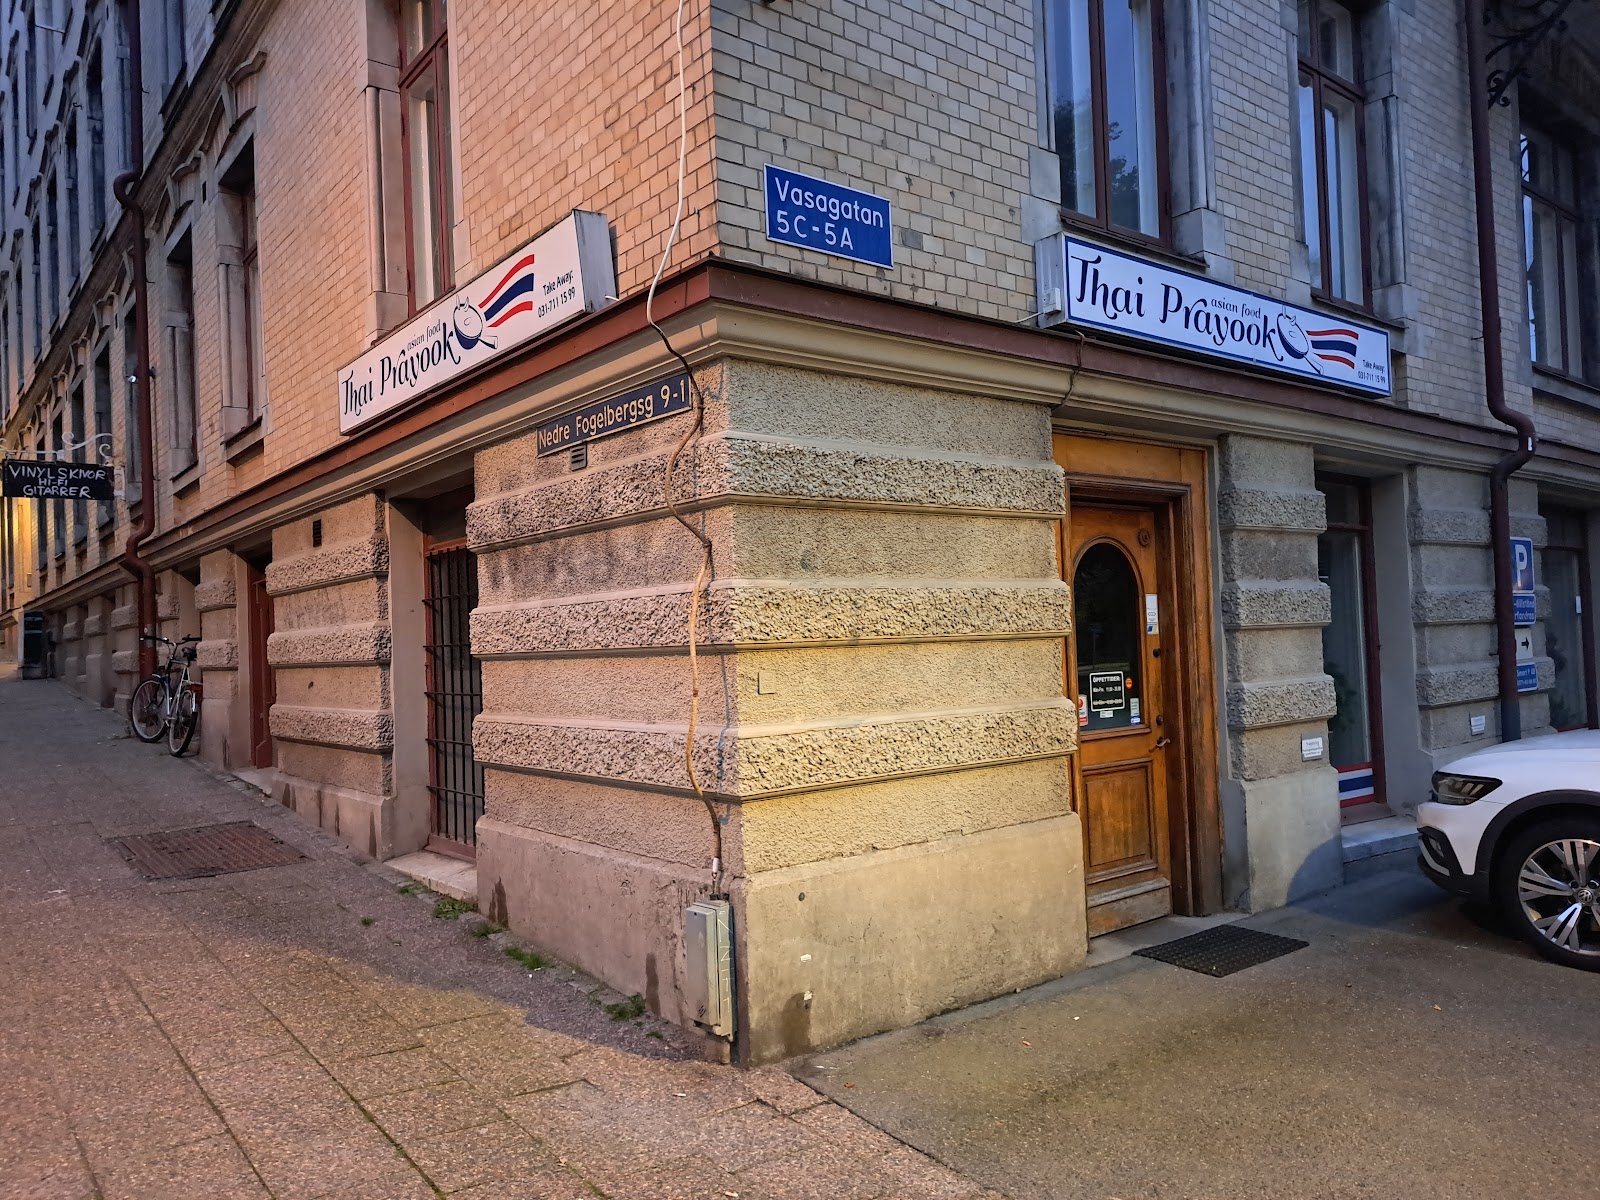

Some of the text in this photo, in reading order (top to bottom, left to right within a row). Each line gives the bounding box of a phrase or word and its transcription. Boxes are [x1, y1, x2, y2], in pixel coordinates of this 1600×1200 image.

[774, 176, 884, 229] Vasagatan
[543, 281, 556, 296] Take
[560, 291, 568, 305] 15
[568, 286, 576, 300] 99
[1070, 254, 1284, 362] Thai Prayook
[1211, 297, 1261, 319] asian food
[407, 319, 441, 352] asian food
[341, 321, 461, 417] Thai Prayook
[1362, 359, 1372, 369] Take
[538, 423, 570, 450] Nedre
[575, 394, 654, 437] Fogelbergsg
[23, 484, 91, 498] GITARRER
[38, 478, 68, 487] HI-FI
[1514, 543, 1528, 588] P
